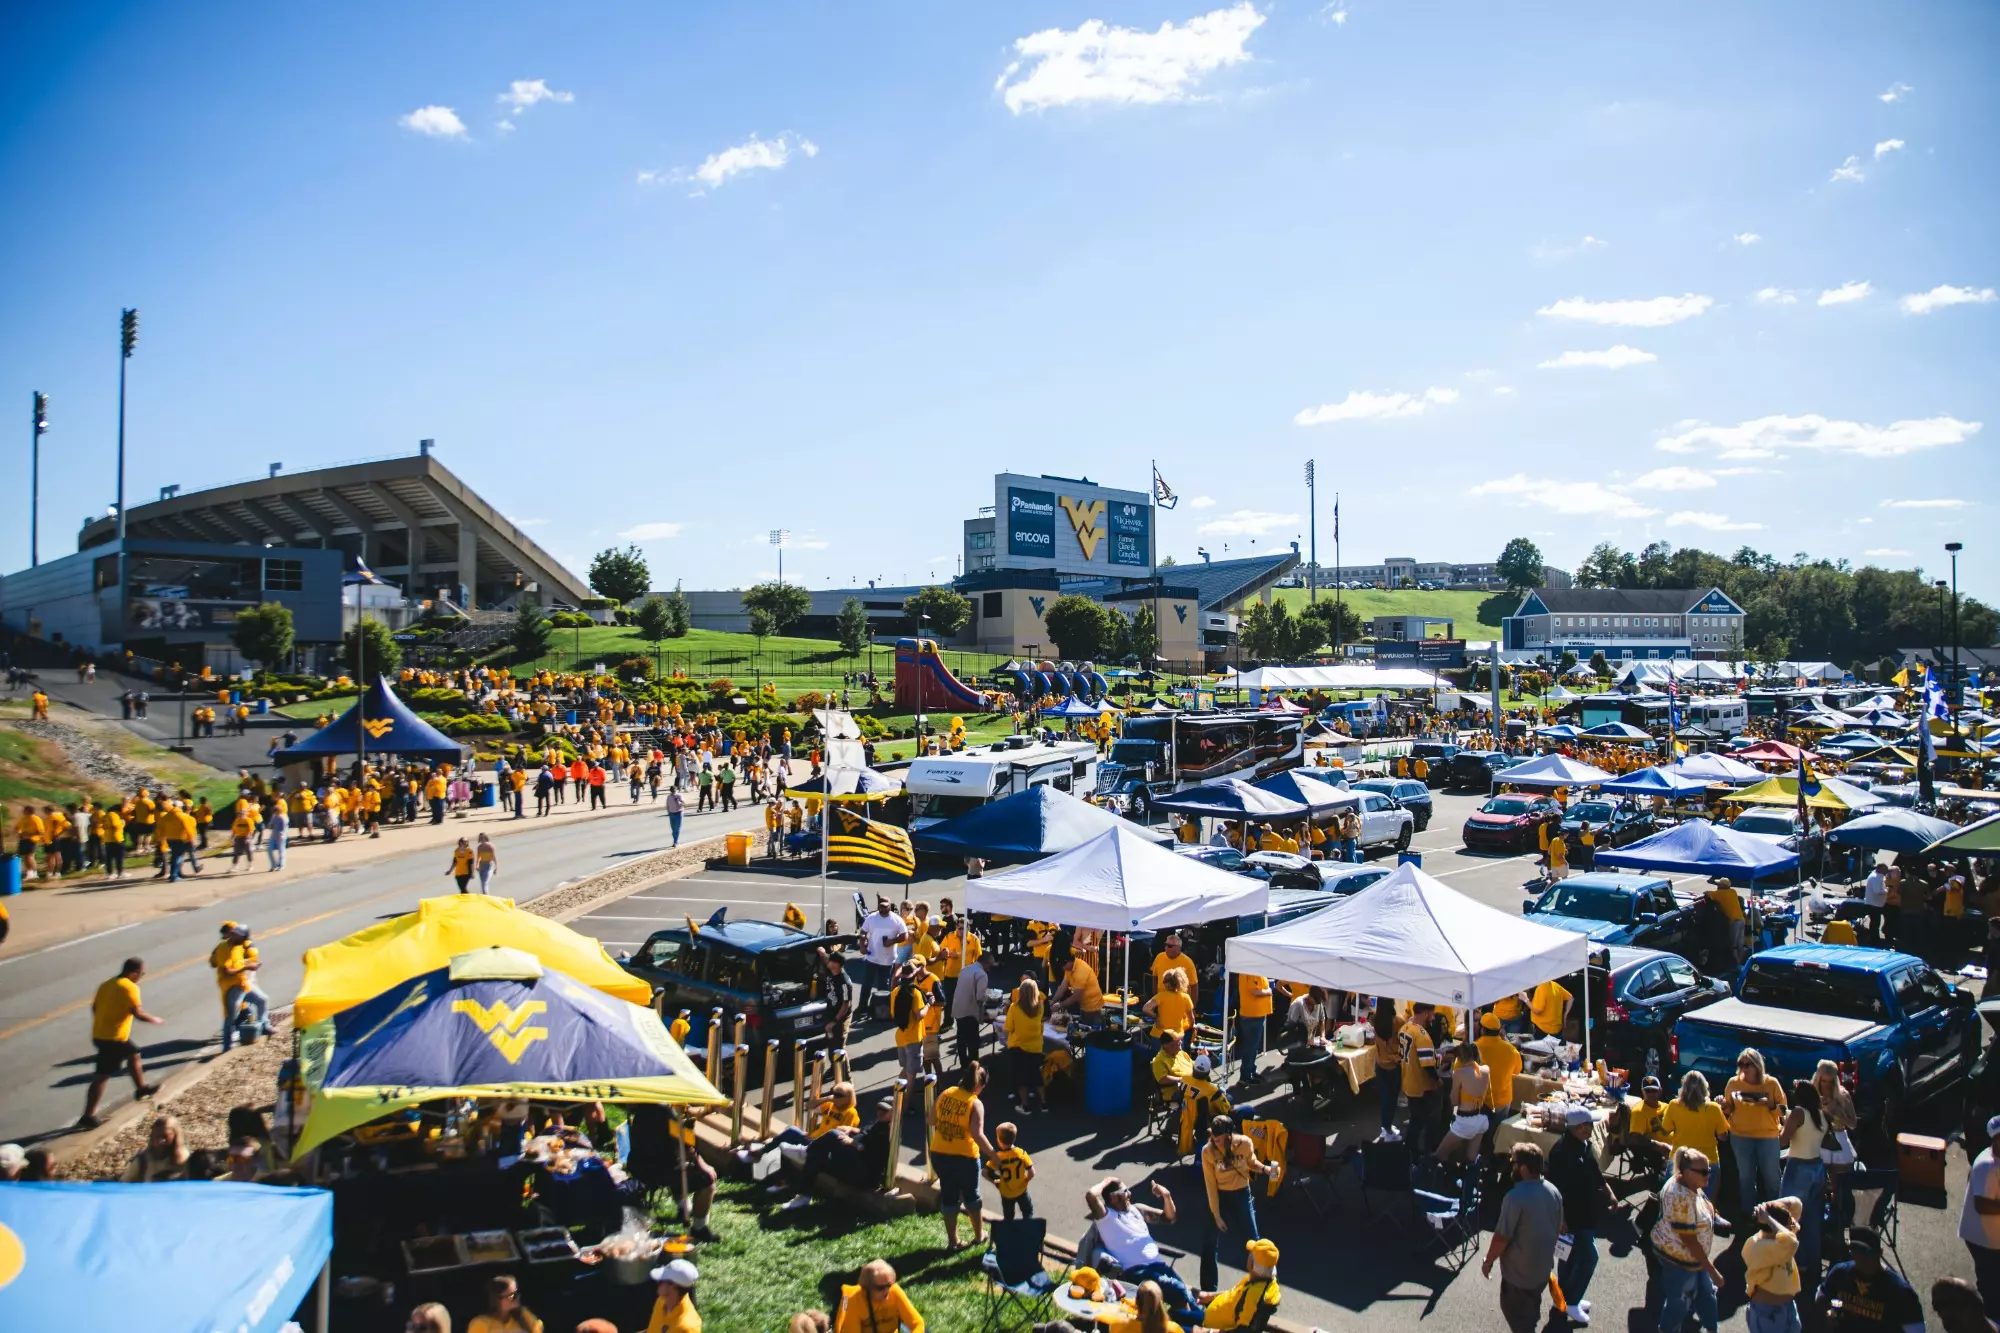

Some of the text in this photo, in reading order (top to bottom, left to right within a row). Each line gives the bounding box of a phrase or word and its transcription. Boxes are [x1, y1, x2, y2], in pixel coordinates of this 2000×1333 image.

[1020, 500, 1054, 512] Panhandle
[1015, 531, 1050, 544] encova
[1117, 550, 1140, 560] Campbell
[926, 768, 964, 777] FORESTER
